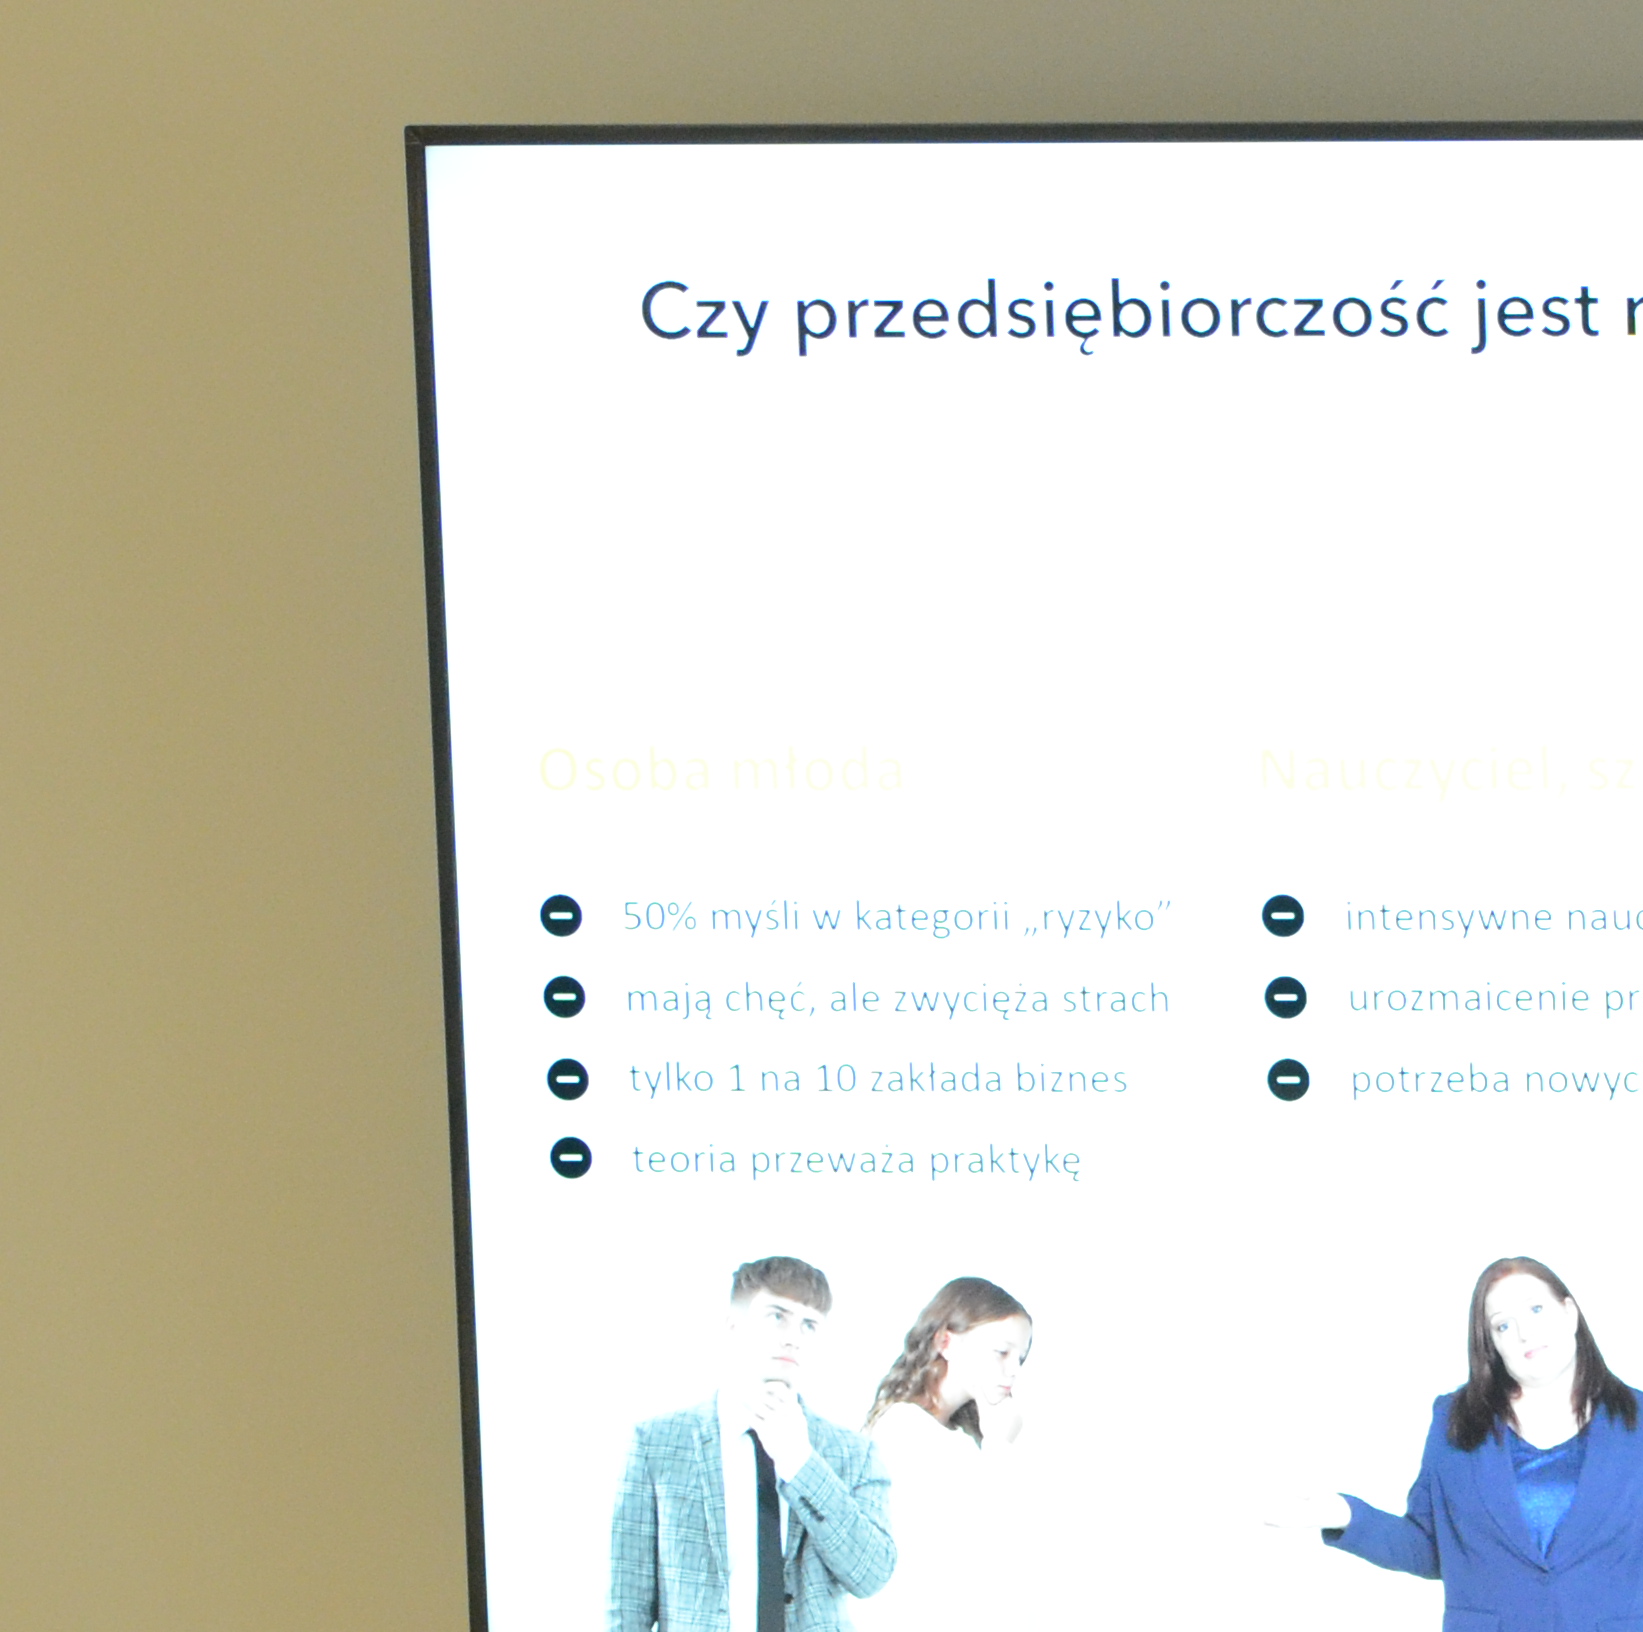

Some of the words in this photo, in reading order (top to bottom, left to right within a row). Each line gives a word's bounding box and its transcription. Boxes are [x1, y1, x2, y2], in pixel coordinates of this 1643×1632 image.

[642, 280, 769, 356] Czy
[797, 278, 1449, 356] przedsiębiorczość
[1471, 279, 1599, 354] jest
[540, 746, 709, 791] Osoba
[734, 746, 902, 790] młoda
[1261, 746, 1568, 801] Nauczyciel,
[624, 901, 697, 932] 50%
[711, 900, 799, 939] myśli
[812, 909, 842, 931] w
[855, 900, 1009, 940] kategorii
[1023, 900, 1171, 940] „ryzyko”
[1346, 901, 1553, 939] intensywne
[627, 981, 713, 1021] mają
[725, 980, 817, 1021] chęć,
[830, 981, 881, 1013] ale
[894, 982, 1049, 1021] zwycięża
[1063, 981, 1169, 1013] strach
[1349, 981, 1591, 1012] urozmaicenie
[628, 1061, 715, 1100] tylko
[729, 1063, 746, 1092] 1
[761, 1070, 801, 1092] na
[817, 1063, 857, 1093] 10
[870, 1061, 1003, 1093] zakłada
[1016, 1061, 1129, 1093] biznes
[1352, 1062, 1511, 1101] potrzeba
[631, 1143, 737, 1174] teoria
[751, 1144, 915, 1182] przeważa
[930, 1143, 1081, 1183] praktykę
